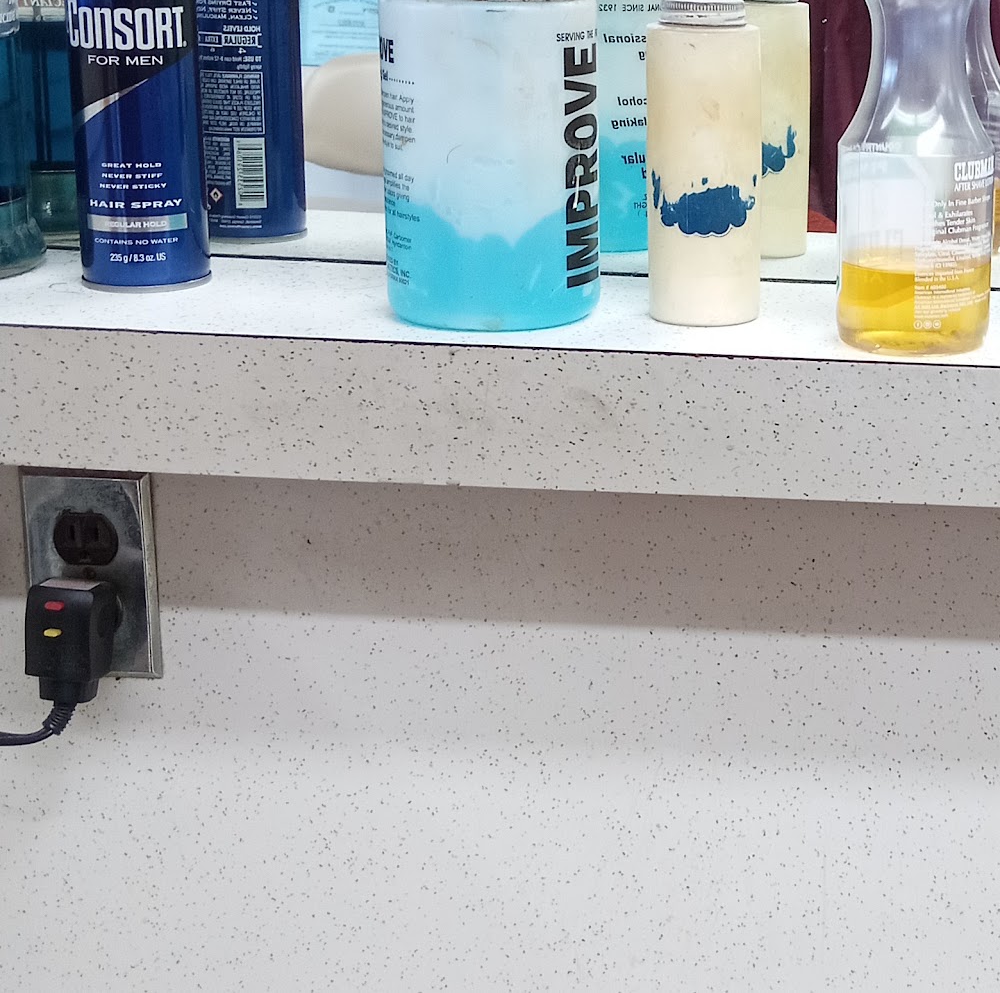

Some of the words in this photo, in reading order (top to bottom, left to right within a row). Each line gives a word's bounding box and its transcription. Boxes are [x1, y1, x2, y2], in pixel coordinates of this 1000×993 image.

[556, 31, 585, 43] SERVING
[87, 54, 121, 66] FOR
[125, 54, 164, 67] MEN
[563, 42, 599, 290] IMPROVE
[132, 182, 167, 190] STICKY
[954, 181, 971, 193] AFTER
[89, 198, 126, 209] HAIR
[130, 198, 183, 209] SPRAY
[955, 198, 968, 207] Fine
[104, 220, 142, 229] REGULAR
[142, 220, 169, 229] HOLD
[946, 218, 966, 228] Tender
[965, 216, 977, 226] Skin
[947, 224, 972, 234] Clubman
[94, 237, 134, 246] CONTAINS
[135, 238, 149, 246] NO
[150, 236, 179, 245] WATER
[156, 251, 168, 262] US
